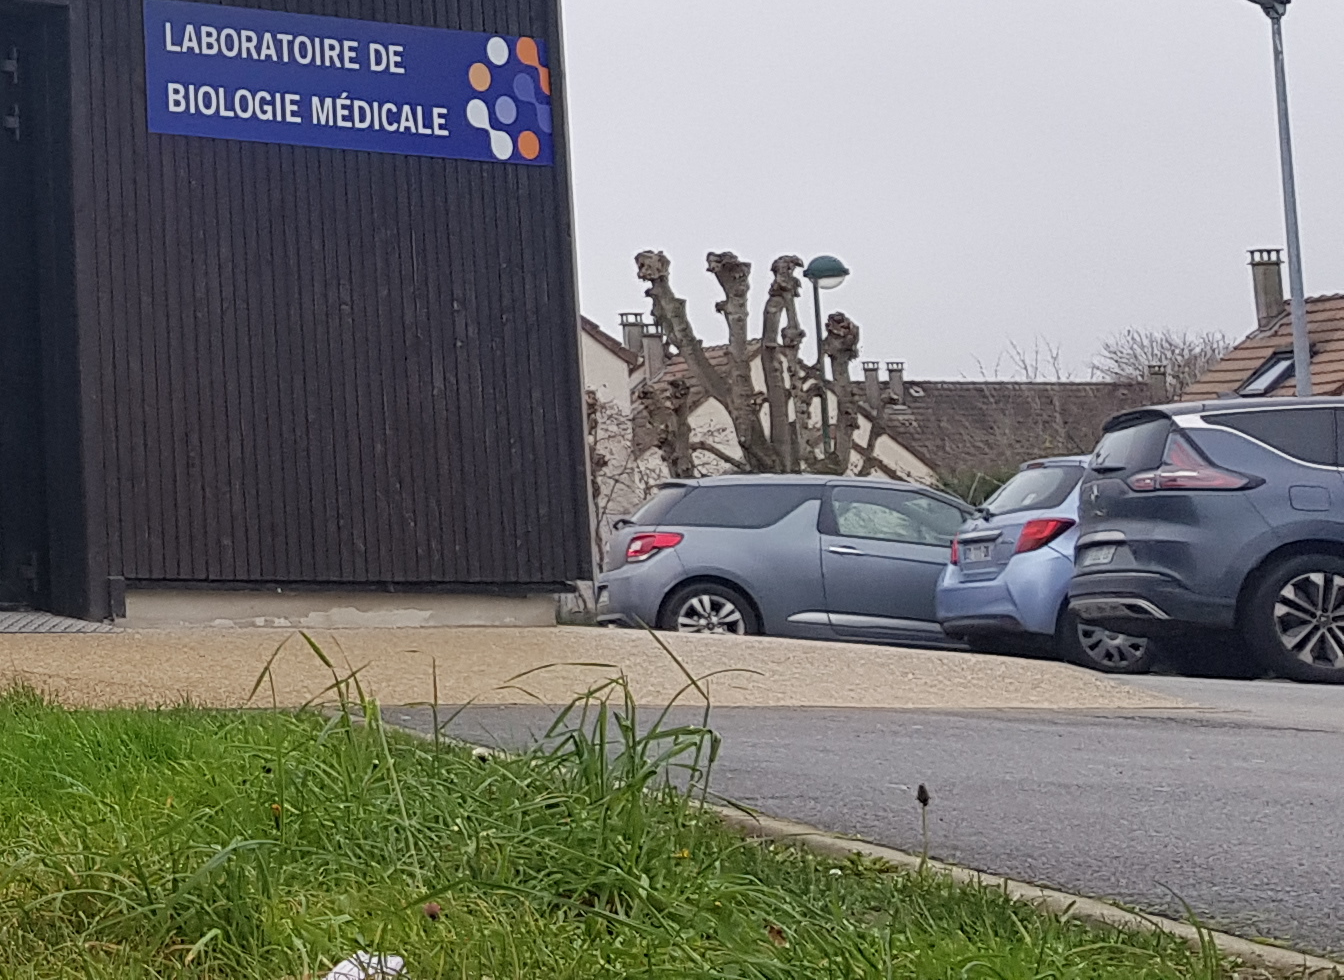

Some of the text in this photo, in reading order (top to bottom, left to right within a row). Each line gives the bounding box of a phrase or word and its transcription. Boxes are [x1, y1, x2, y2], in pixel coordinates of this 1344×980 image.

[165, 21, 406, 74] LABORATOIRE DE
[167, 82, 450, 137] BIOLOGIE MÉDICALE
